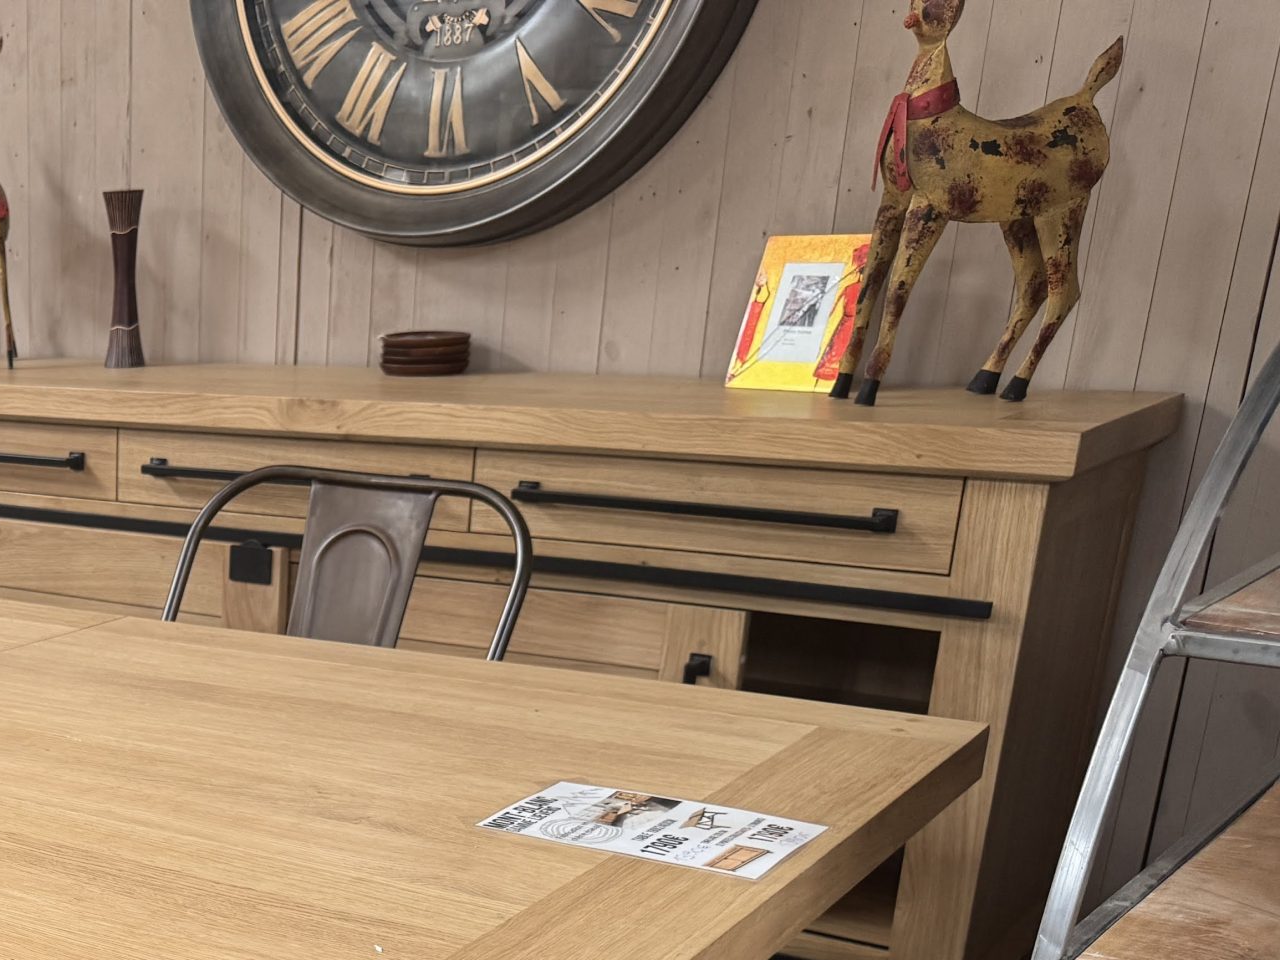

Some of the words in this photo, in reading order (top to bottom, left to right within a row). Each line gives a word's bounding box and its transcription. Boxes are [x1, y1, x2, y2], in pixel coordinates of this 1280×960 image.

[435, 23, 474, 47] 1887
[482, 796, 559, 829] MONT-BLANC
[640, 834, 690, 856] 1790€
